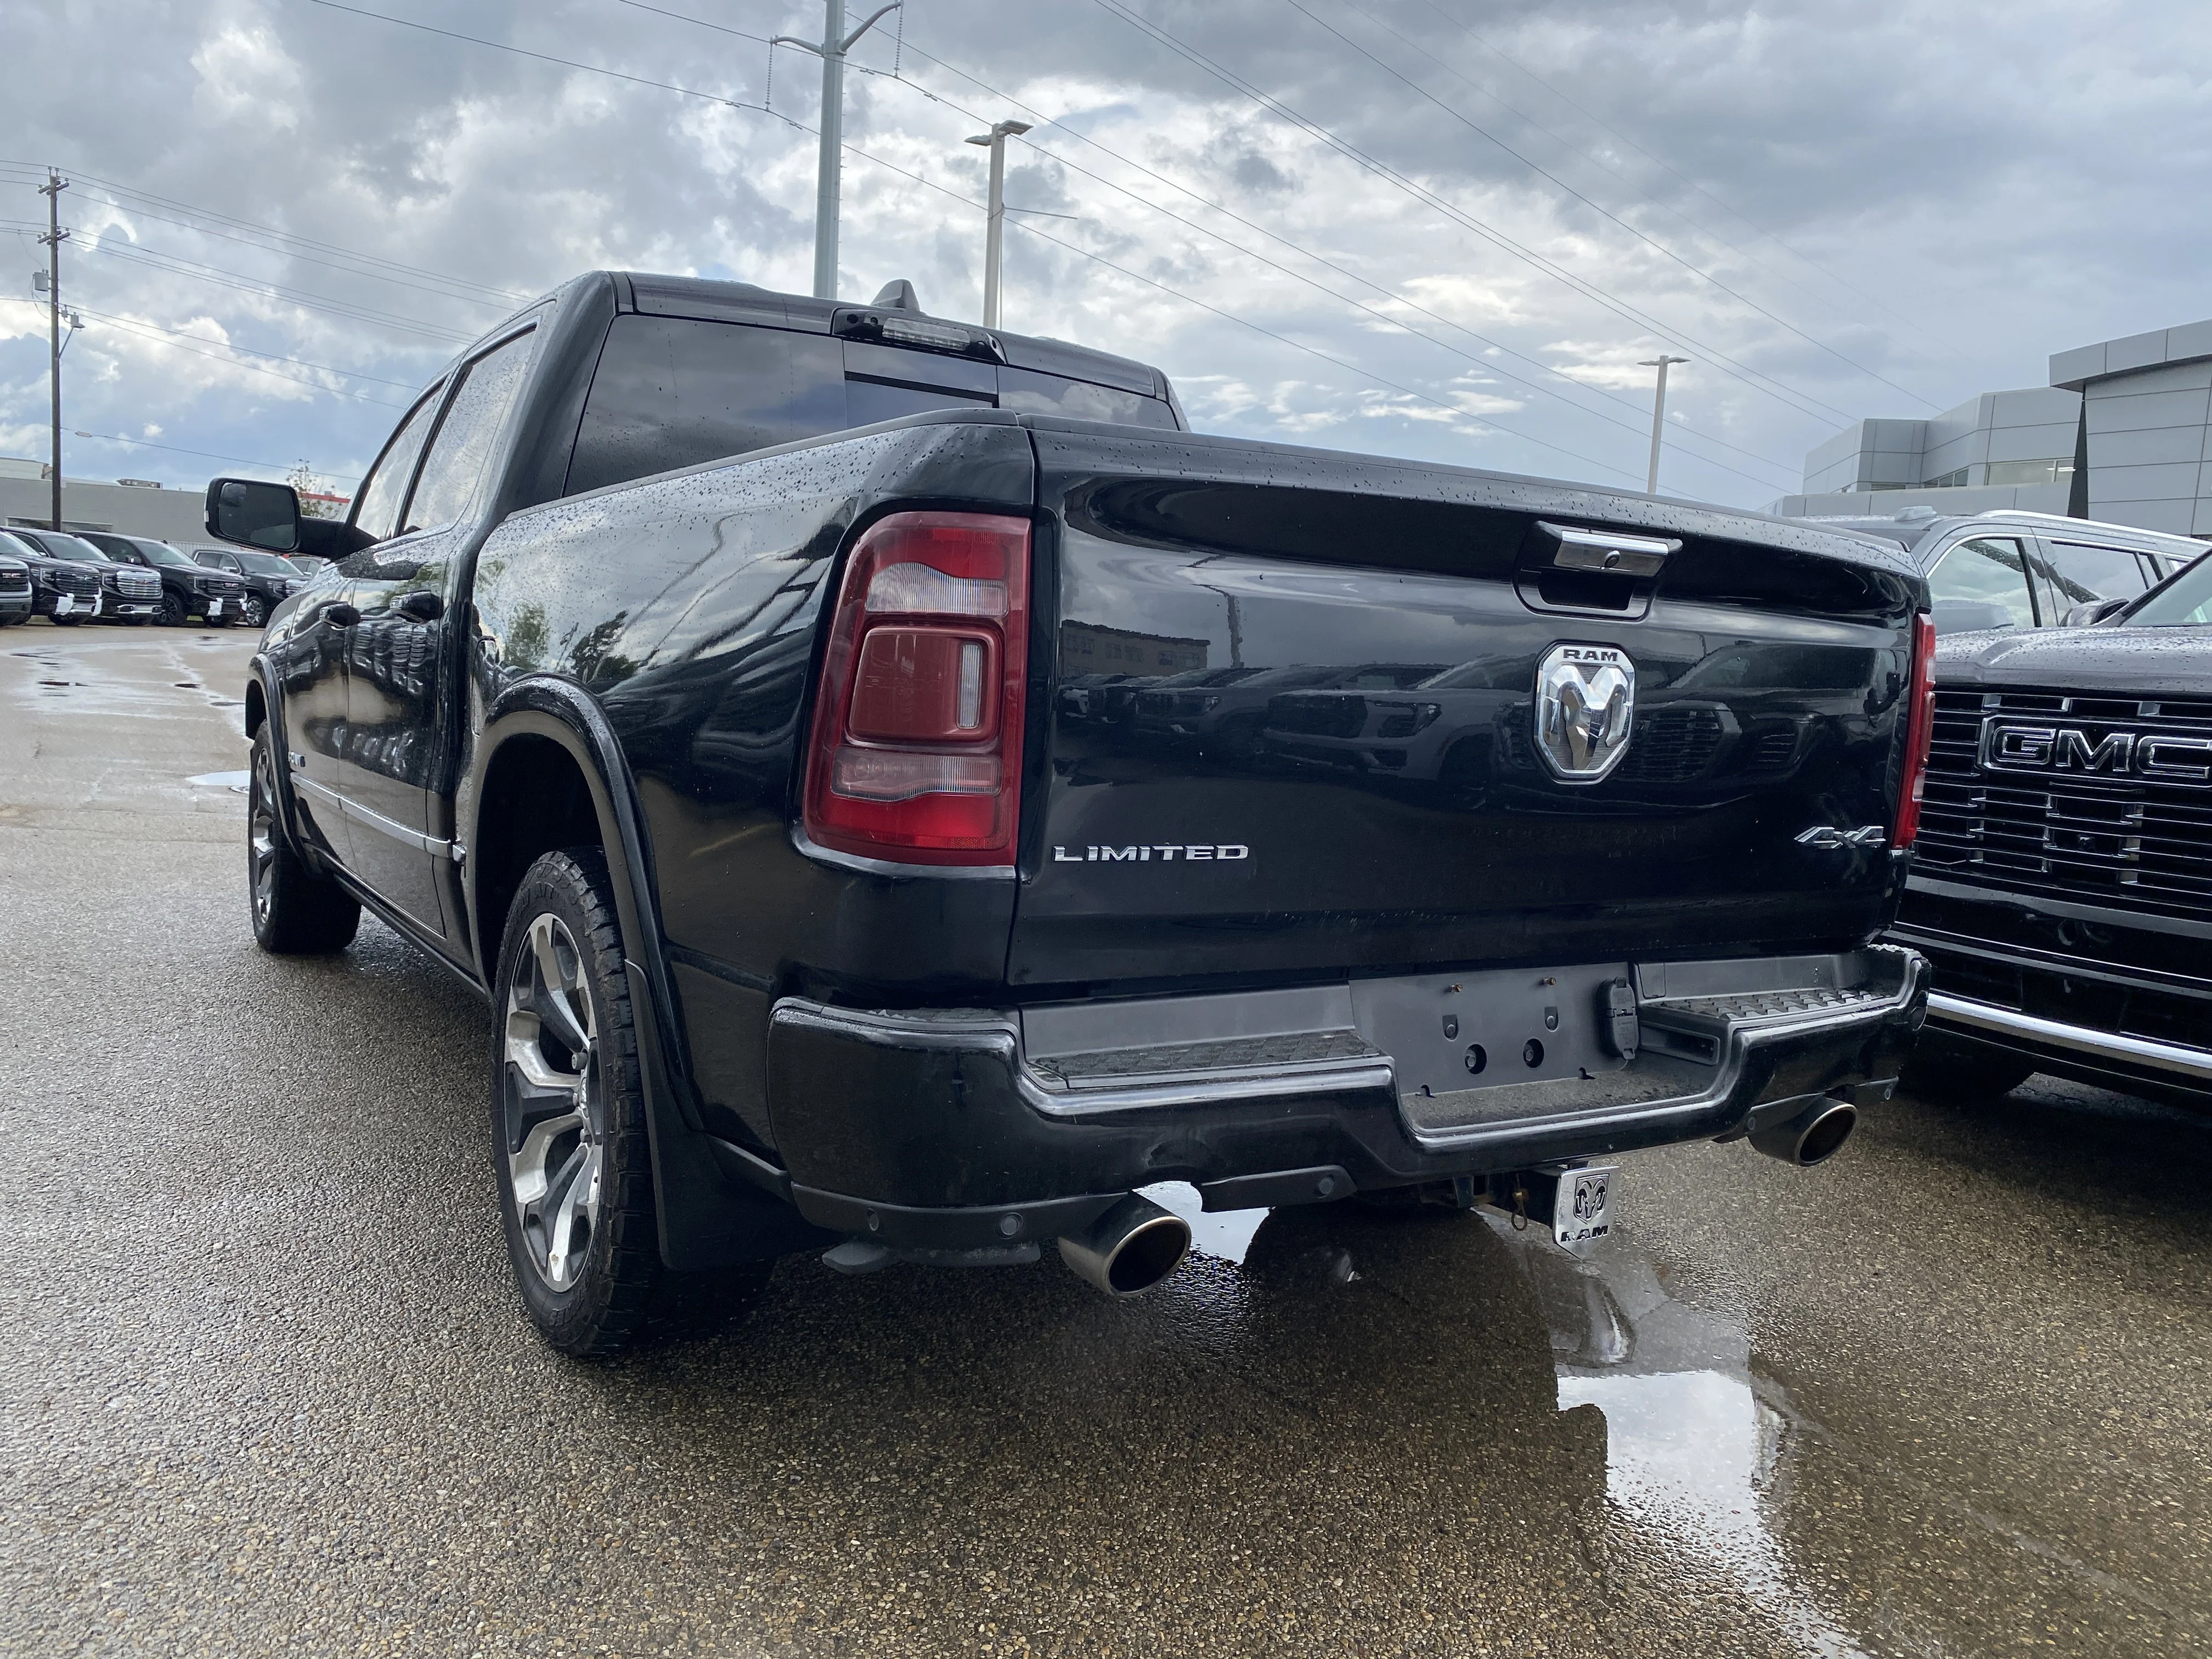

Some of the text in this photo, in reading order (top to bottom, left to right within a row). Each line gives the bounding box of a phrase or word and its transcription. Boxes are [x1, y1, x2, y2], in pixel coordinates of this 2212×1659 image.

[1563, 648, 1618, 662] RAM
[1993, 725, 2212, 779] GMC
[1052, 845, 1249, 862] LIMITED
[1560, 1225, 1609, 1242] RAM
